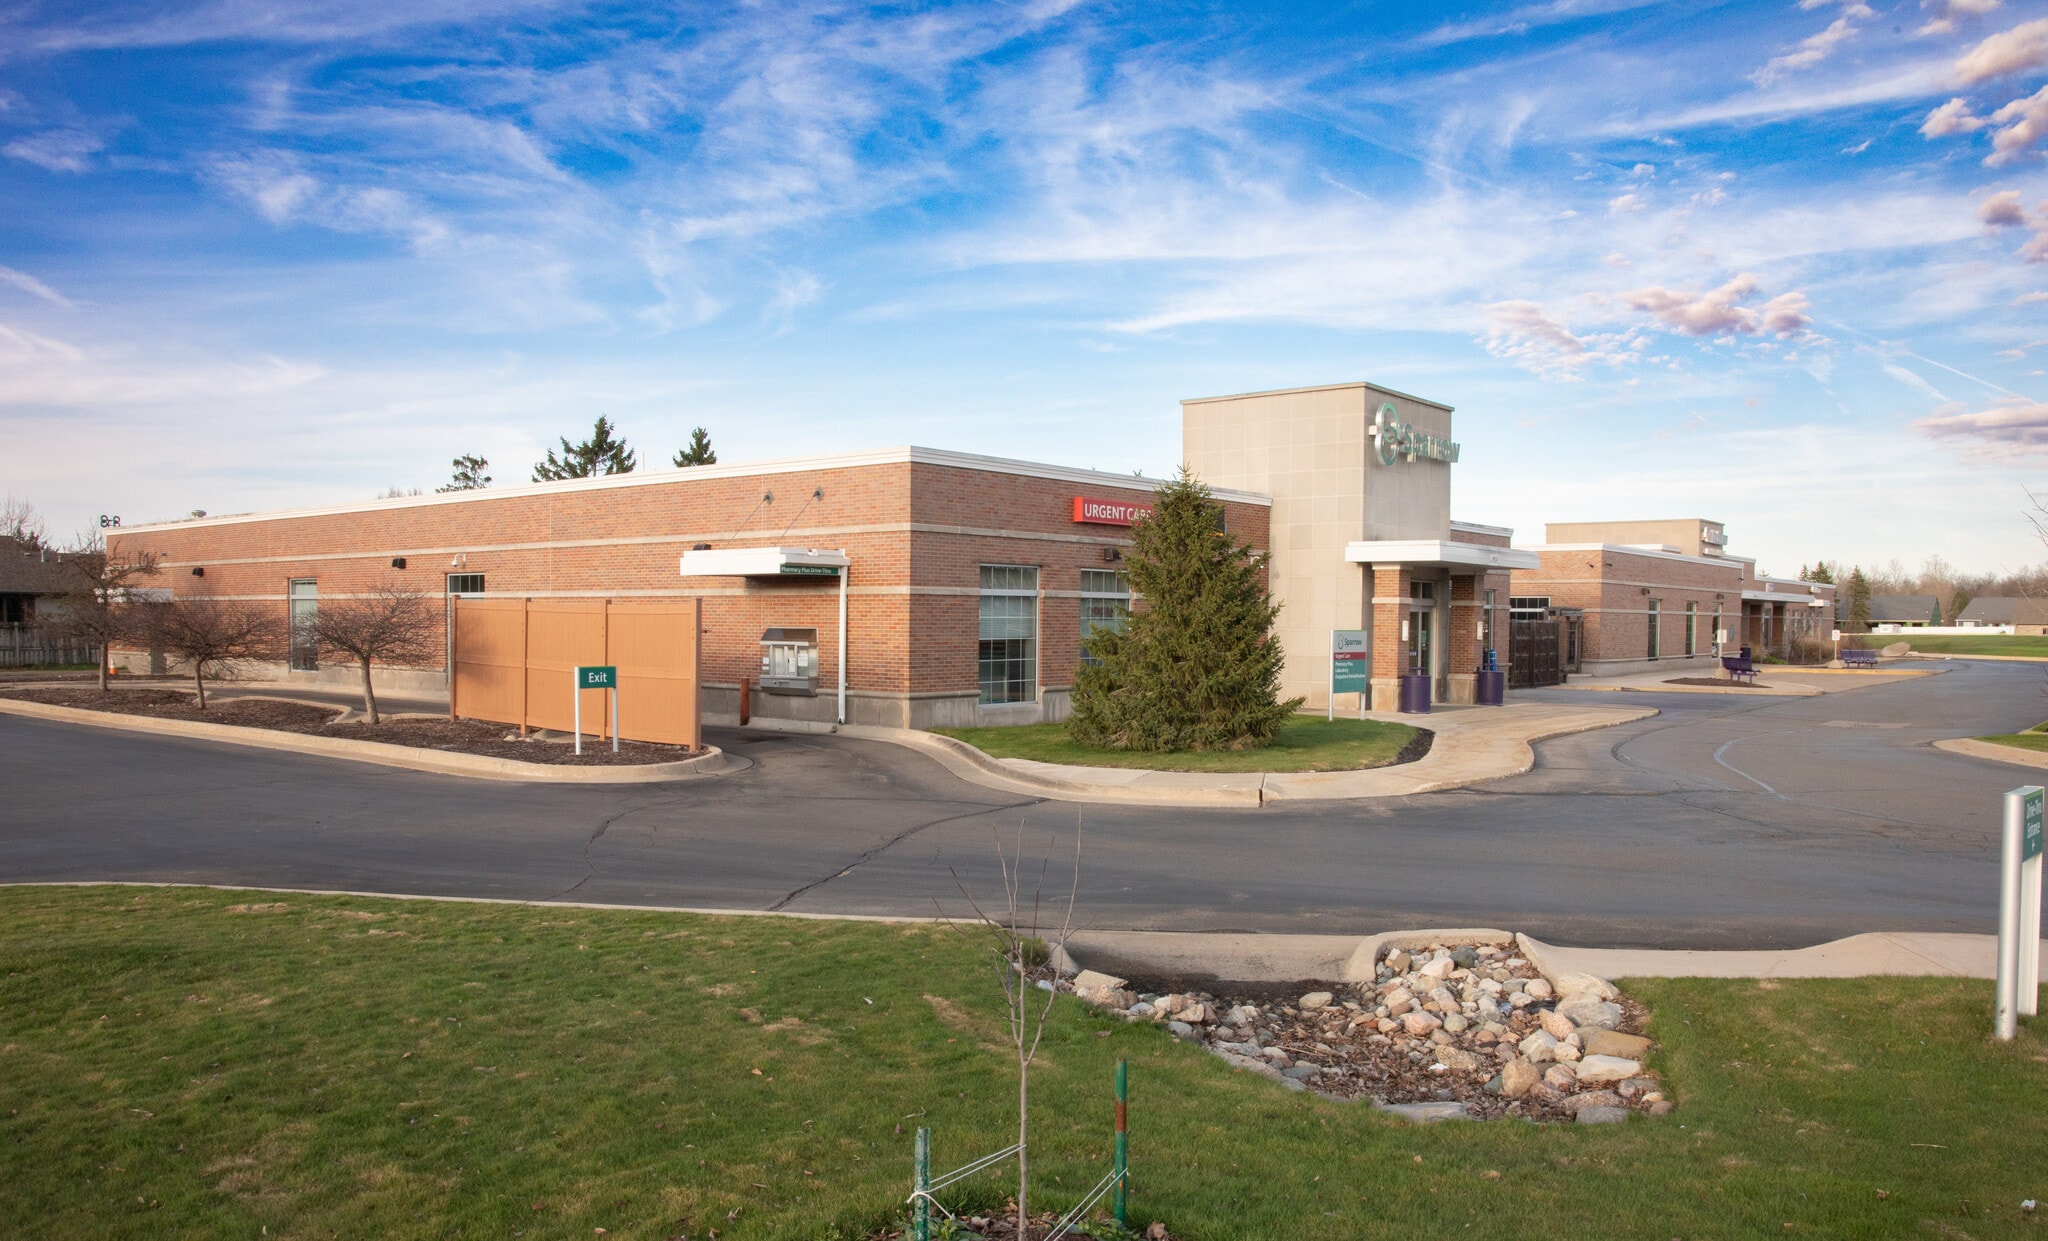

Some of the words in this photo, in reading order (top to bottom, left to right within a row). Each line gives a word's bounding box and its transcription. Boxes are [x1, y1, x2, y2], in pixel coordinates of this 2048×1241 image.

[1403, 423, 1460, 463] Sparrow
[1084, 503, 1125, 520] URGENT
[781, 566, 801, 574] Pharmacy
[1344, 638, 1362, 648] Sparrow
[588, 671, 608, 683] Exit
